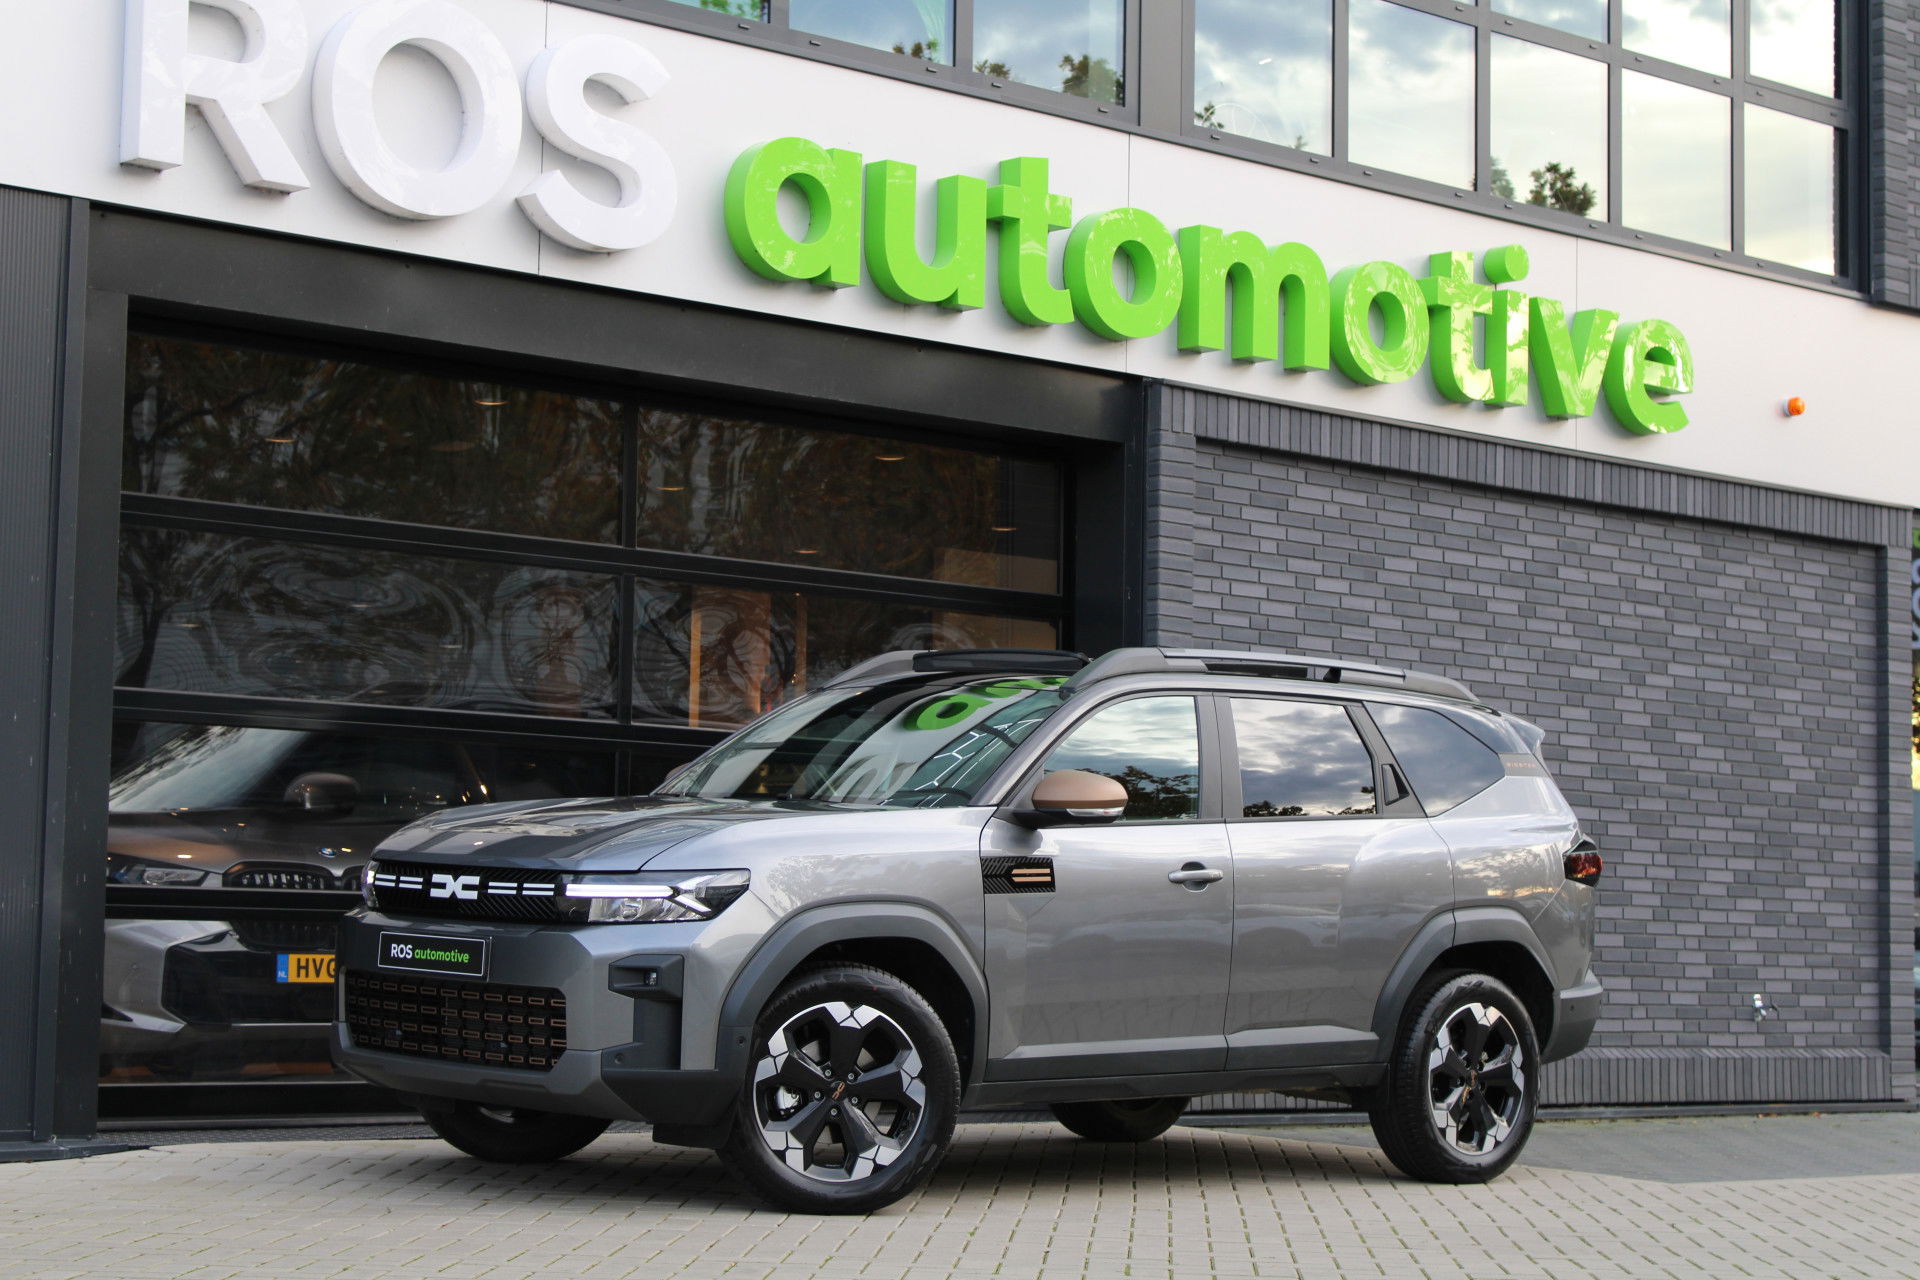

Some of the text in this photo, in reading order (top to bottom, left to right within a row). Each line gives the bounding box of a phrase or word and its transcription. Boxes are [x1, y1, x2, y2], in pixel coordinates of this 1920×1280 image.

[119, 0, 1694, 435] ROS automotive
[390, 943, 470, 963] ROS automotive
